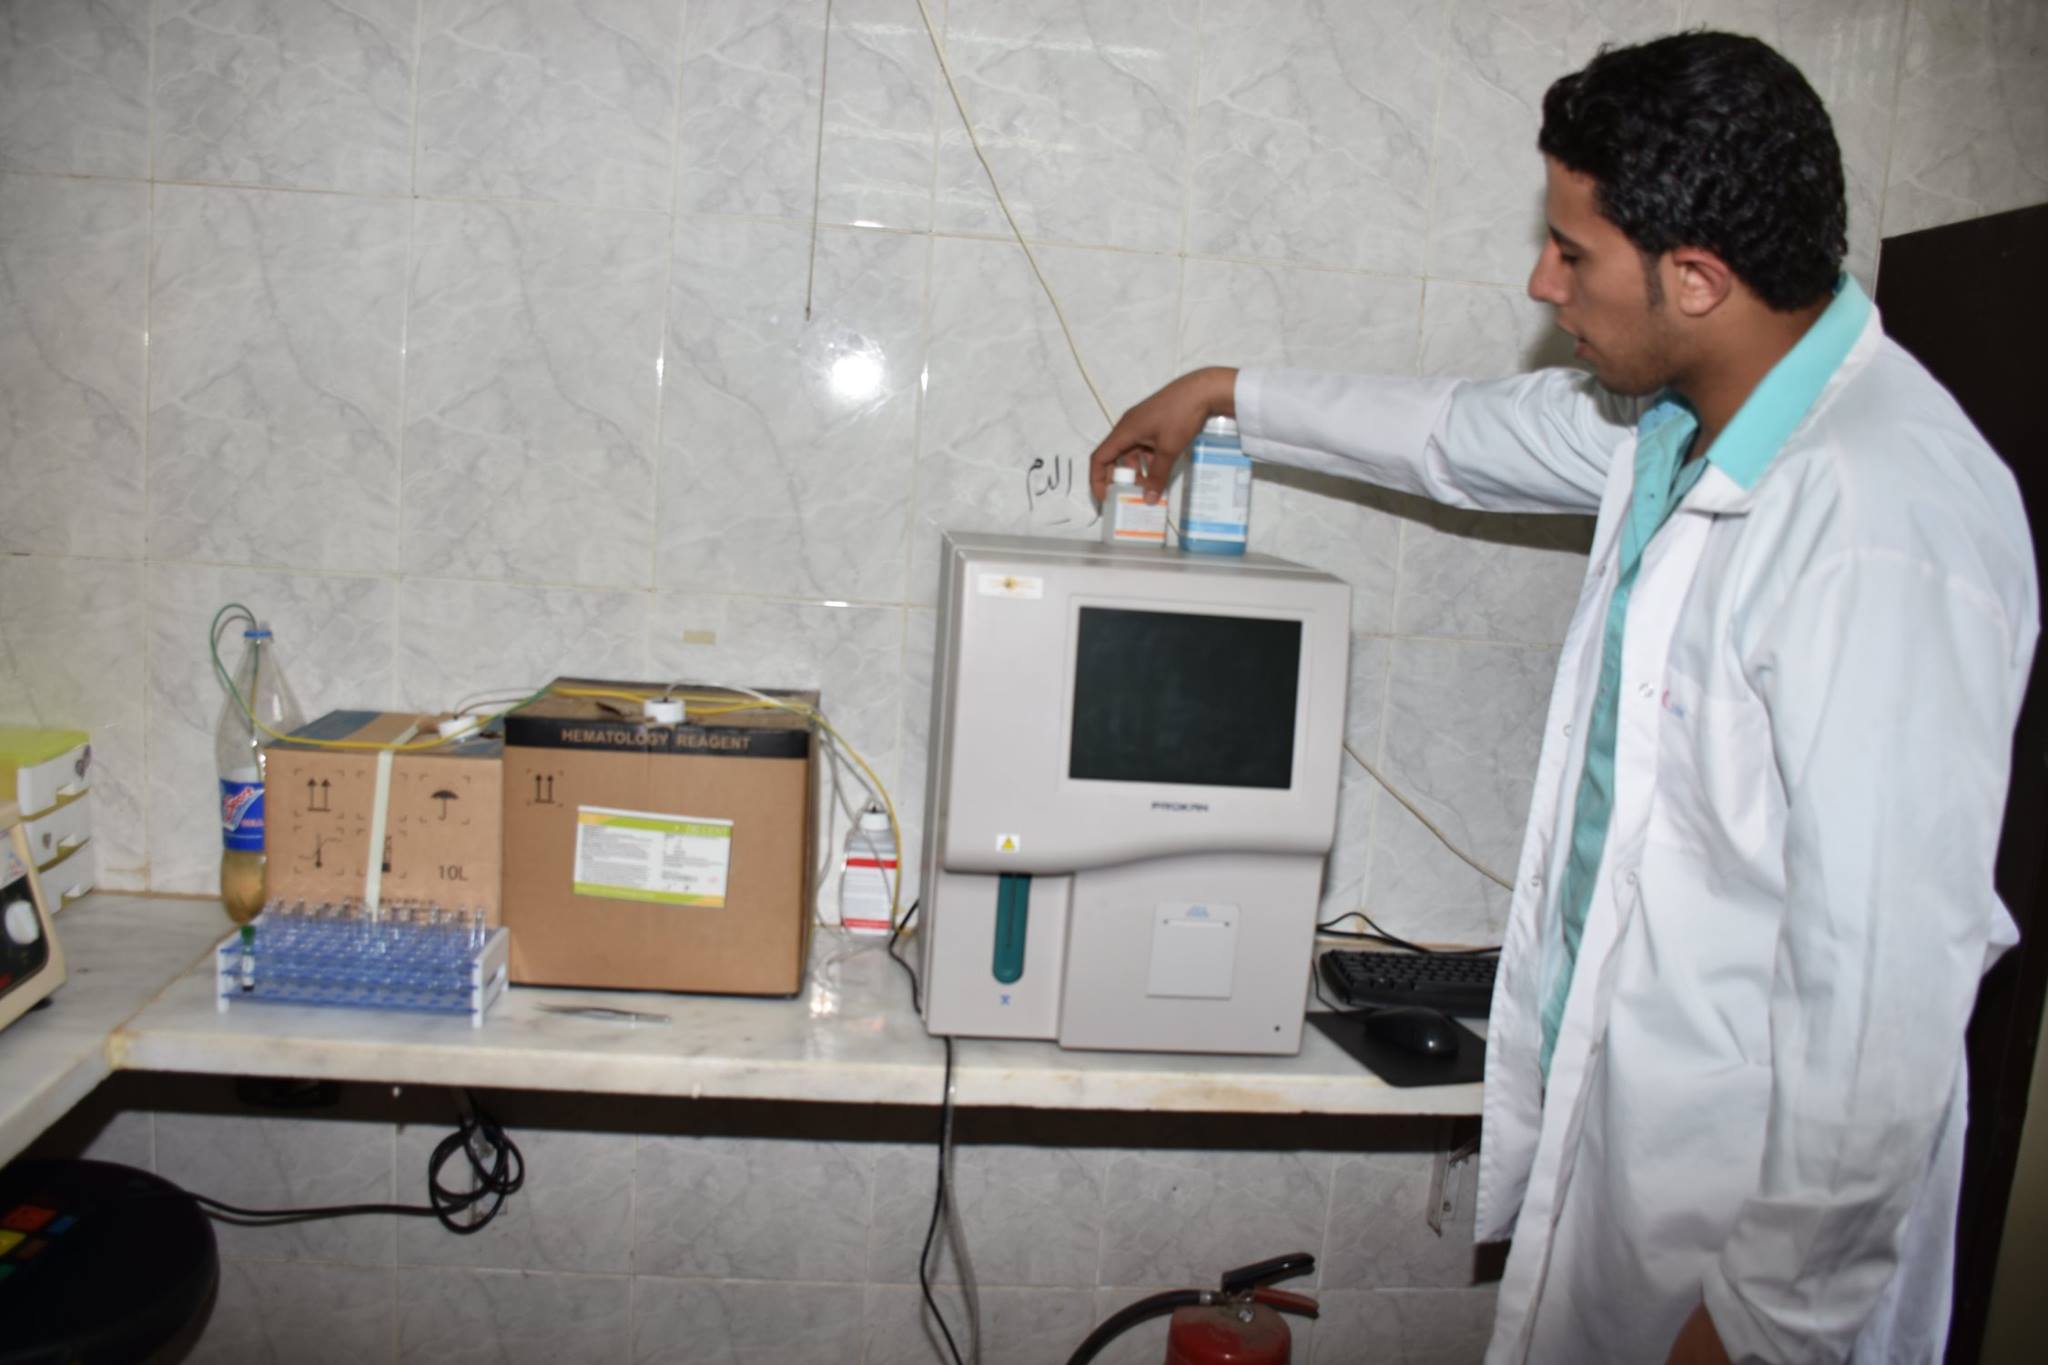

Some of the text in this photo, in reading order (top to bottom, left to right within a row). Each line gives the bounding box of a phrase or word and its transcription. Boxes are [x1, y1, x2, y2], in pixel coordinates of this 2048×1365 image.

[560, 728, 752, 750] HEMATOLOGY REAGENT
[438, 865, 468, 881] 10L
